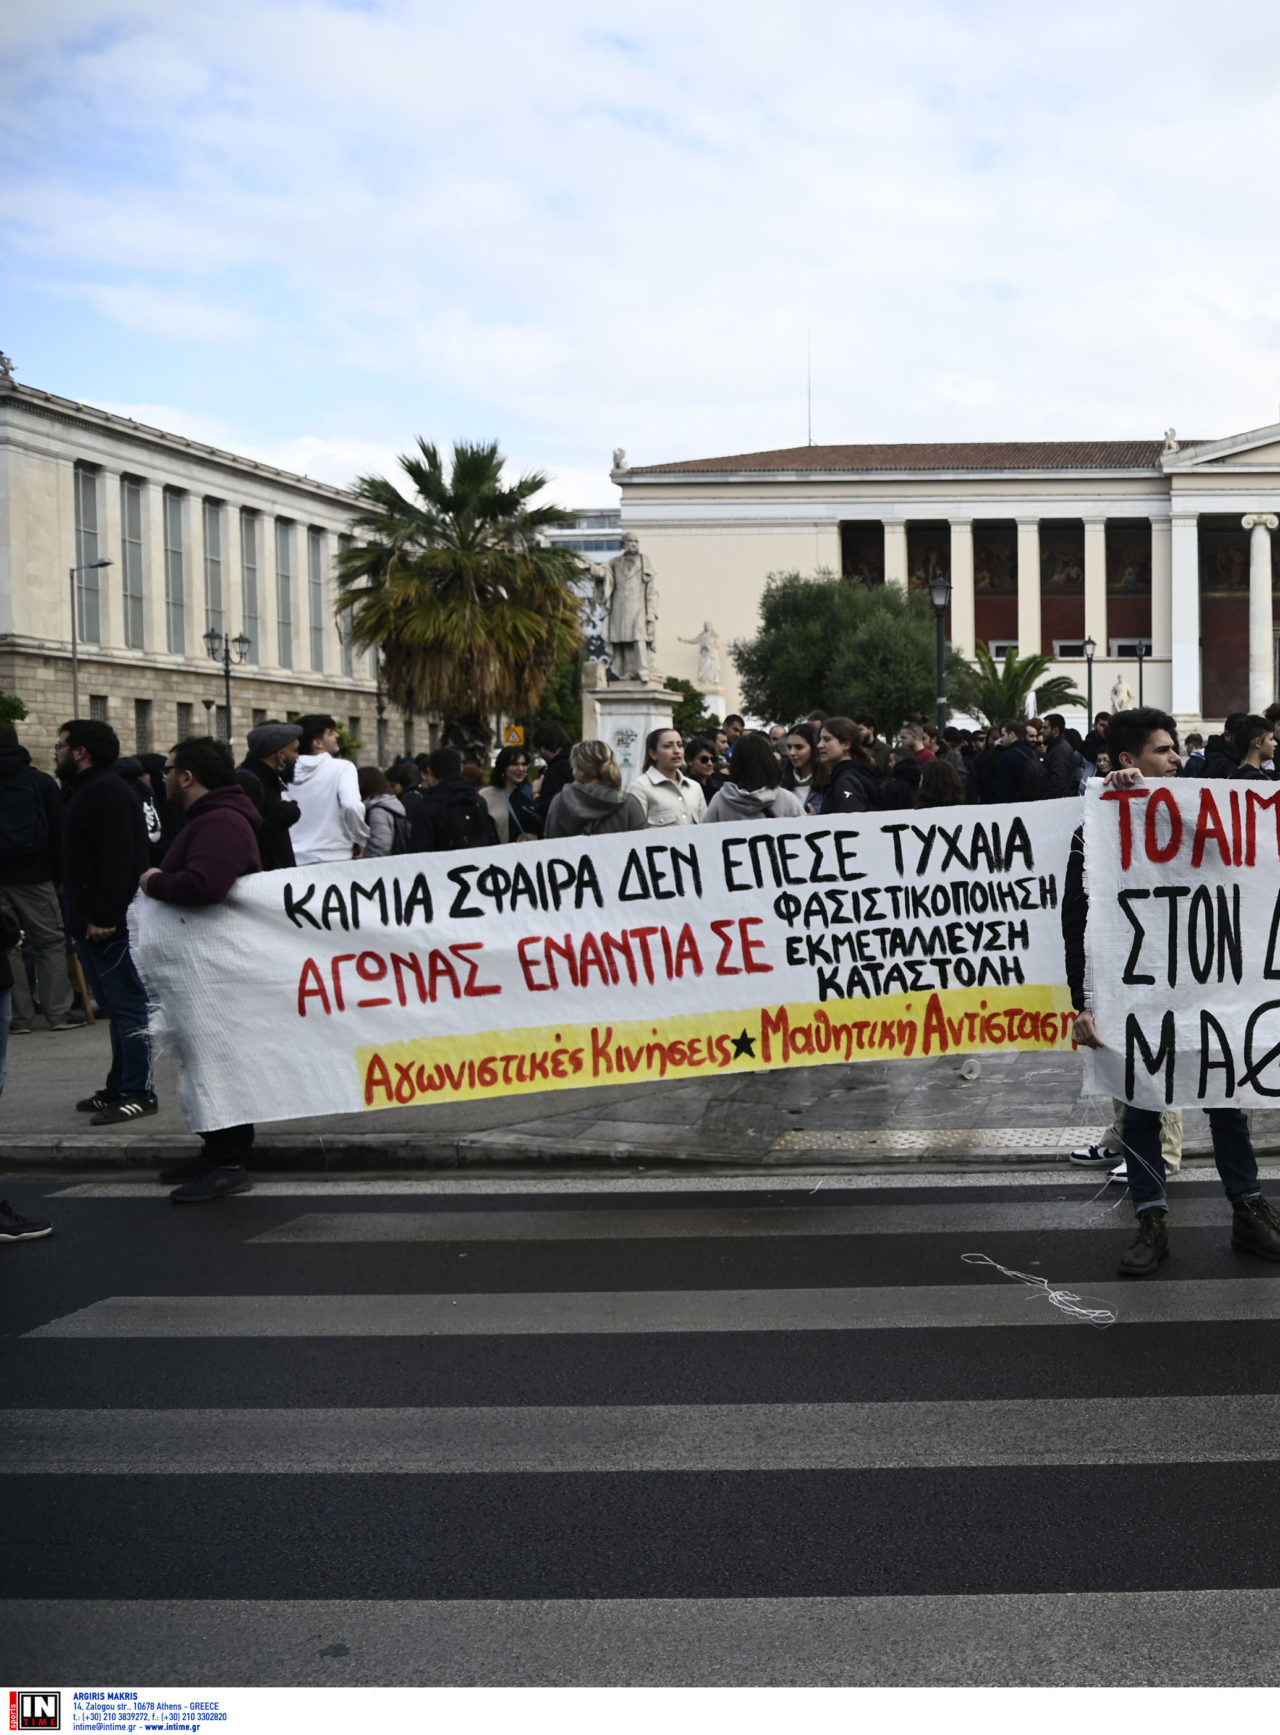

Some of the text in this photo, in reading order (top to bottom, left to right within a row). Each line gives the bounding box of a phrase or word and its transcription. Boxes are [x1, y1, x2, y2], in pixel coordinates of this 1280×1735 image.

[1101, 788, 1182, 869] ΤΟ
[284, 817, 1034, 931] ΚΑΜΙΑ ΣΦΑΙΡΑ ΔΕΝ ΕΠΕΣΕ ΤΥΧΑΙΑ
[774, 874, 1057, 929] ΦΑΣΙΣΤΙΚΟΠΟΙΗΣΗ
[297, 917, 773, 1017] ΑΓΩΝΑΣ ΕΝΑΝΤΙΑ ΣΕ
[786, 919, 1029, 966] ΕΚΜΕΤΑΛΛΕΥΣΗ
[817, 956, 1025, 1001] ΚΑΤΑΣΤΟΛΗ
[1120, 884, 1242, 986] ΣΤΟΝ
[365, 992, 1080, 1106] Αγωνιστικές Κινήσεις Μαθητική Αντίσταση
